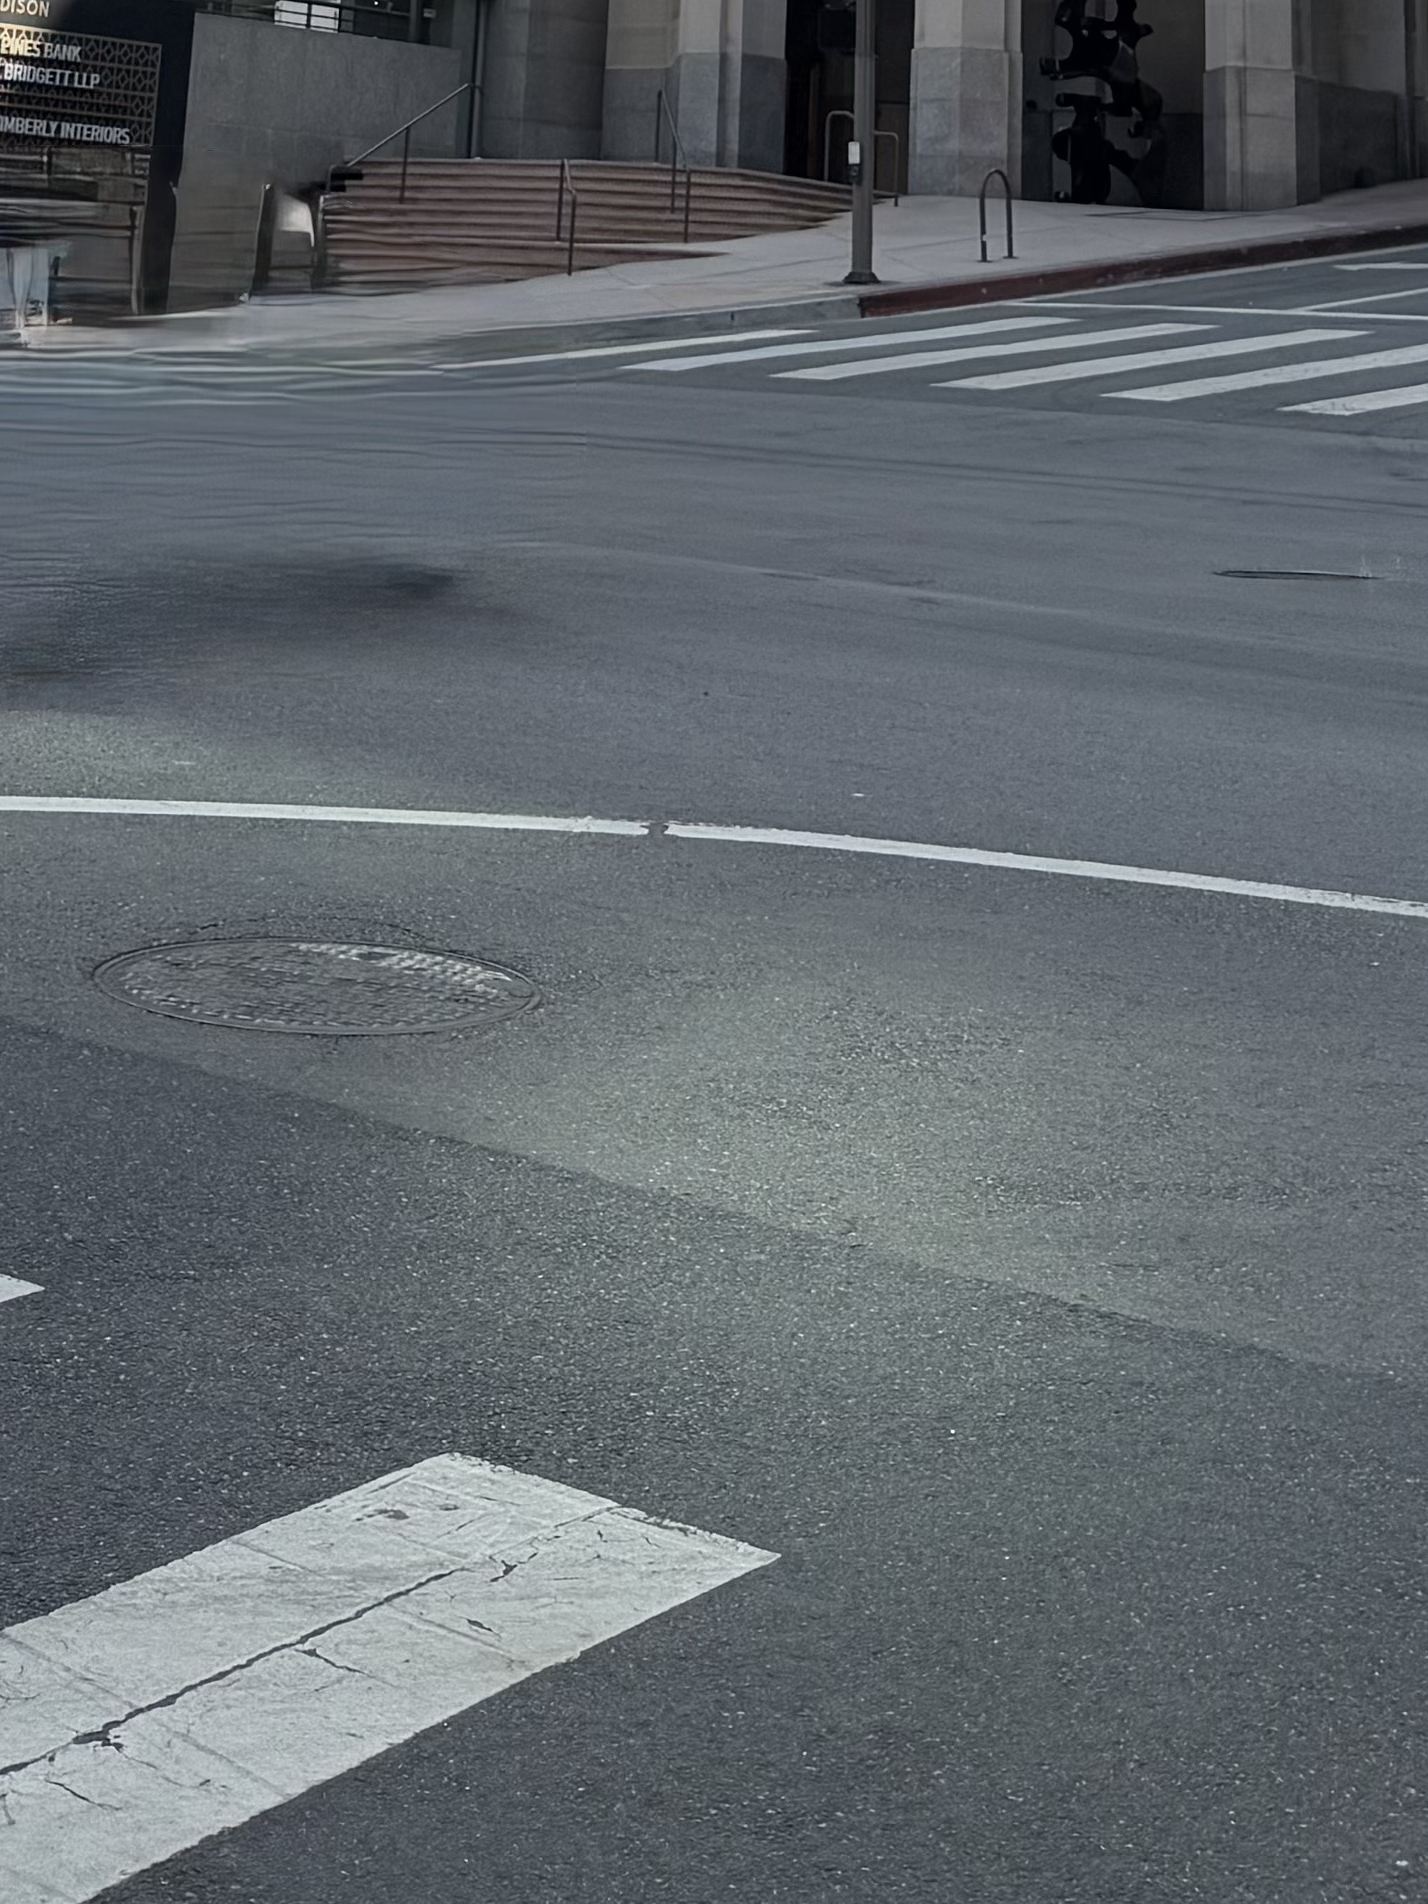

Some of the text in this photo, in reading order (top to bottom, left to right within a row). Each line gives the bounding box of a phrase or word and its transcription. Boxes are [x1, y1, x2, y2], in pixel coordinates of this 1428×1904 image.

[44, 43, 81, 62] BANK
[3, 64, 72, 86] BRIDGETT
[73, 71, 100, 89] LLP
[60, 121, 131, 145] INTERIORS
